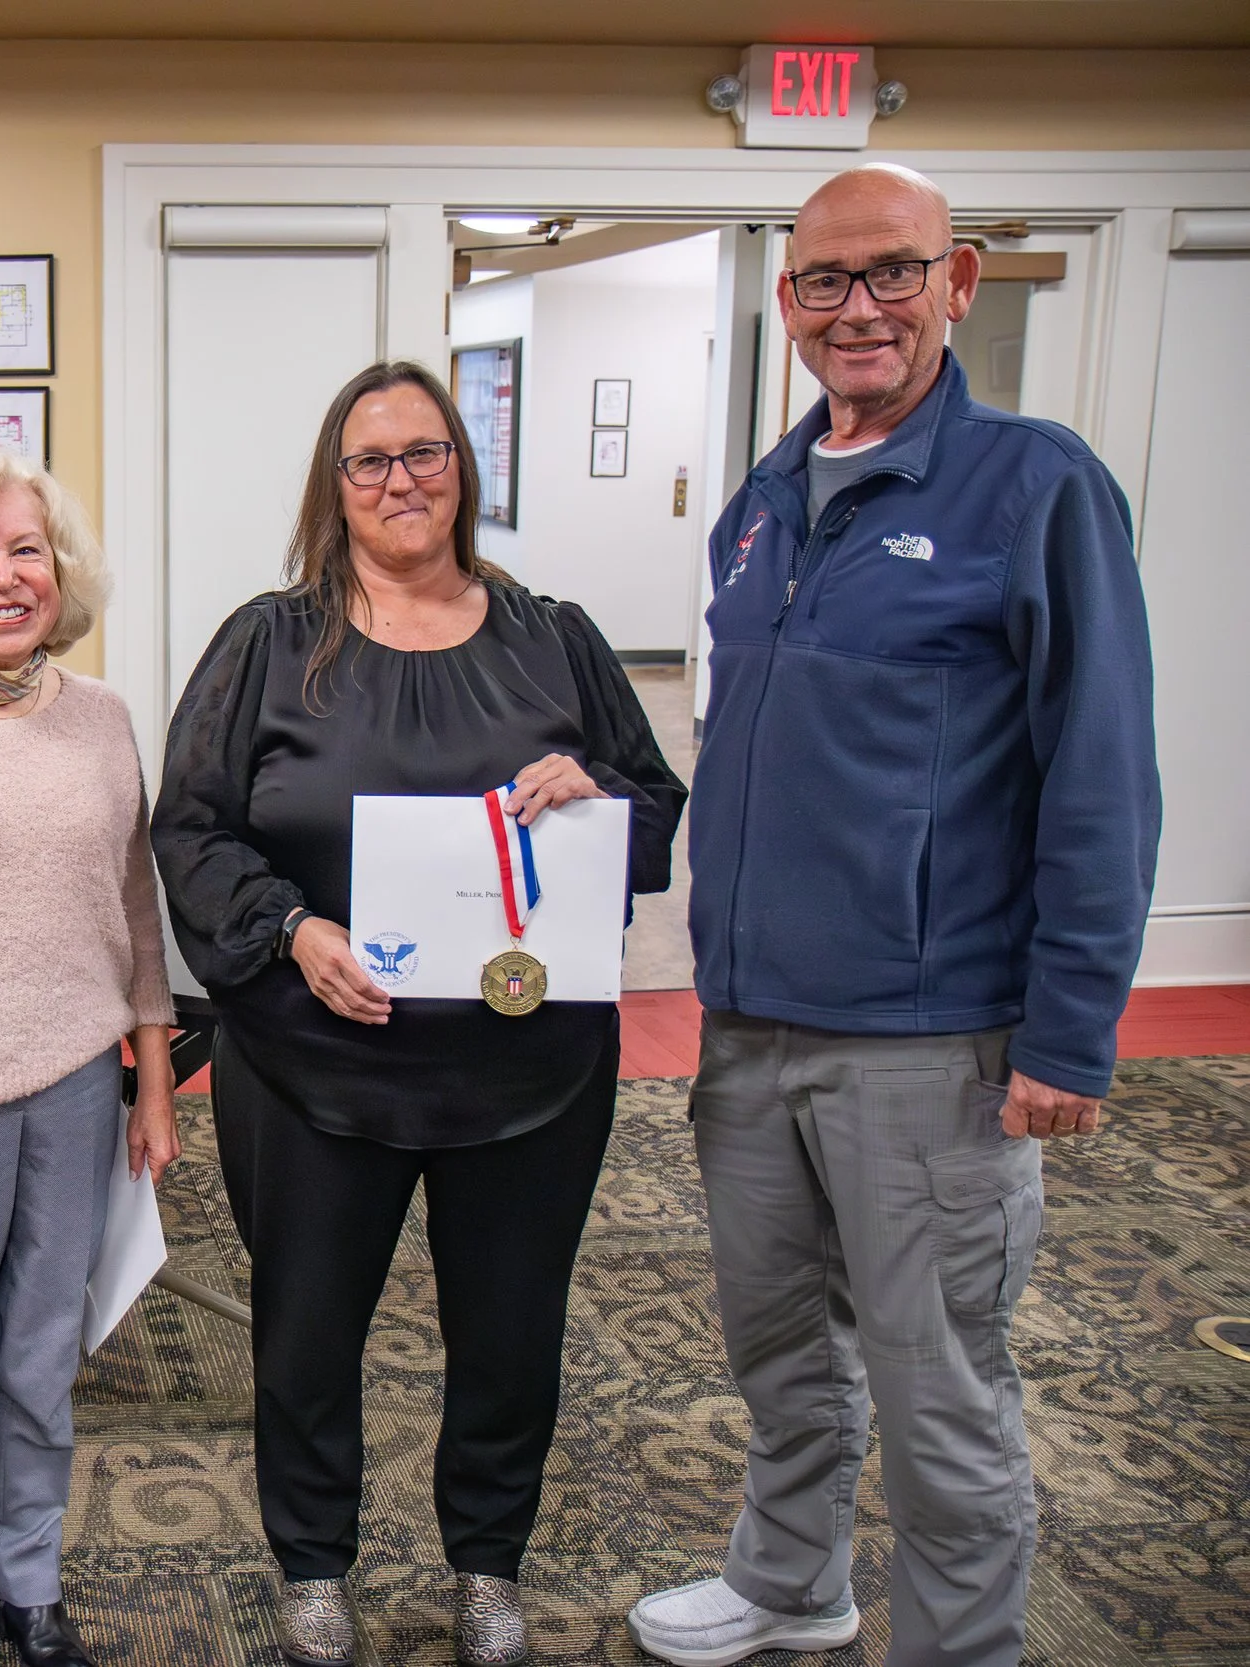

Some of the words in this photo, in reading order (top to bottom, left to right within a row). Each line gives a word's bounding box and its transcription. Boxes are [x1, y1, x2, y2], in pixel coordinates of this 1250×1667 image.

[771, 51, 860, 117] EXIT
[881, 536, 918, 552] NORTH
[900, 532, 920, 545] THE
[888, 547, 914, 558] FACE
